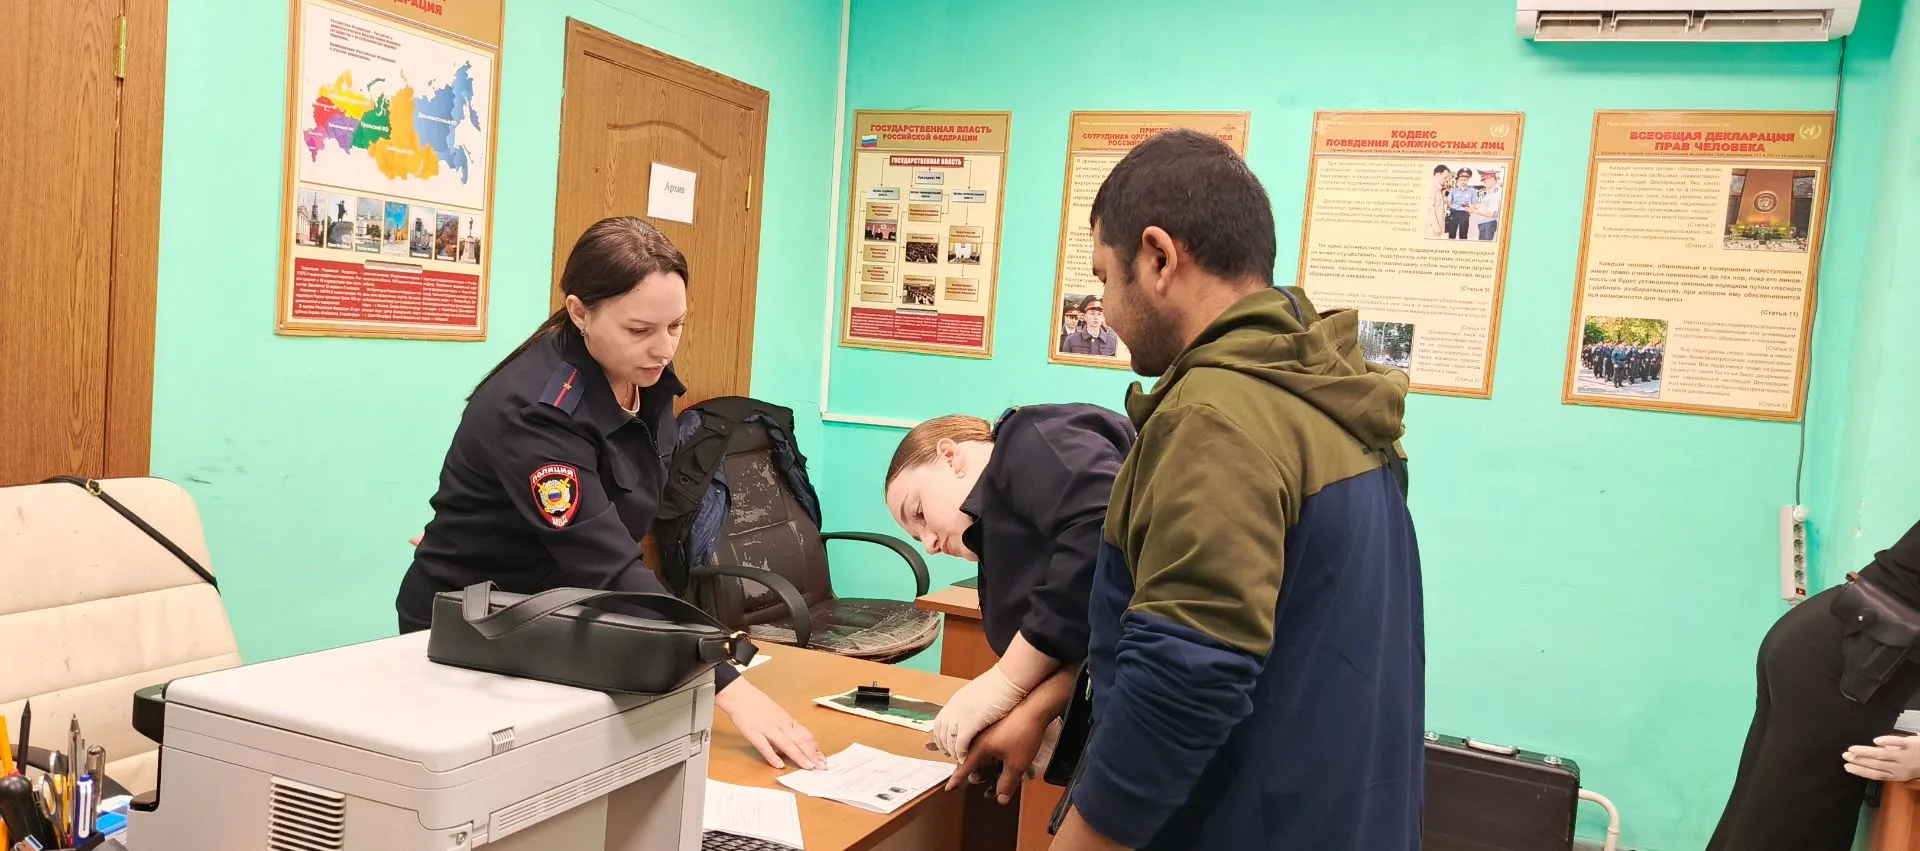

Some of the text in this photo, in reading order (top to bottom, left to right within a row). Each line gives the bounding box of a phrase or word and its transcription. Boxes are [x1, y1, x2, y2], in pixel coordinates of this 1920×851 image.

[870, 124, 992, 134] ГОСУДАРСТВЕННАЯ ВЛАСТЬ
[1391, 130, 1437, 140] КОДЕКС
[1630, 132, 1795, 143] ВСЕОБЩАЯ ДЕКЛАРАЦИЯ
[1326, 139, 1505, 150] ПОВЕДЕНИЯ ДОЛЖНОСТНЫХ ЛИЦ
[1655, 142, 1765, 152] ПРАВ ЧЕЛОВЕКА
[664, 182, 685, 194] Архив
[532, 466, 574, 483] ПОЛИЦИЯ
